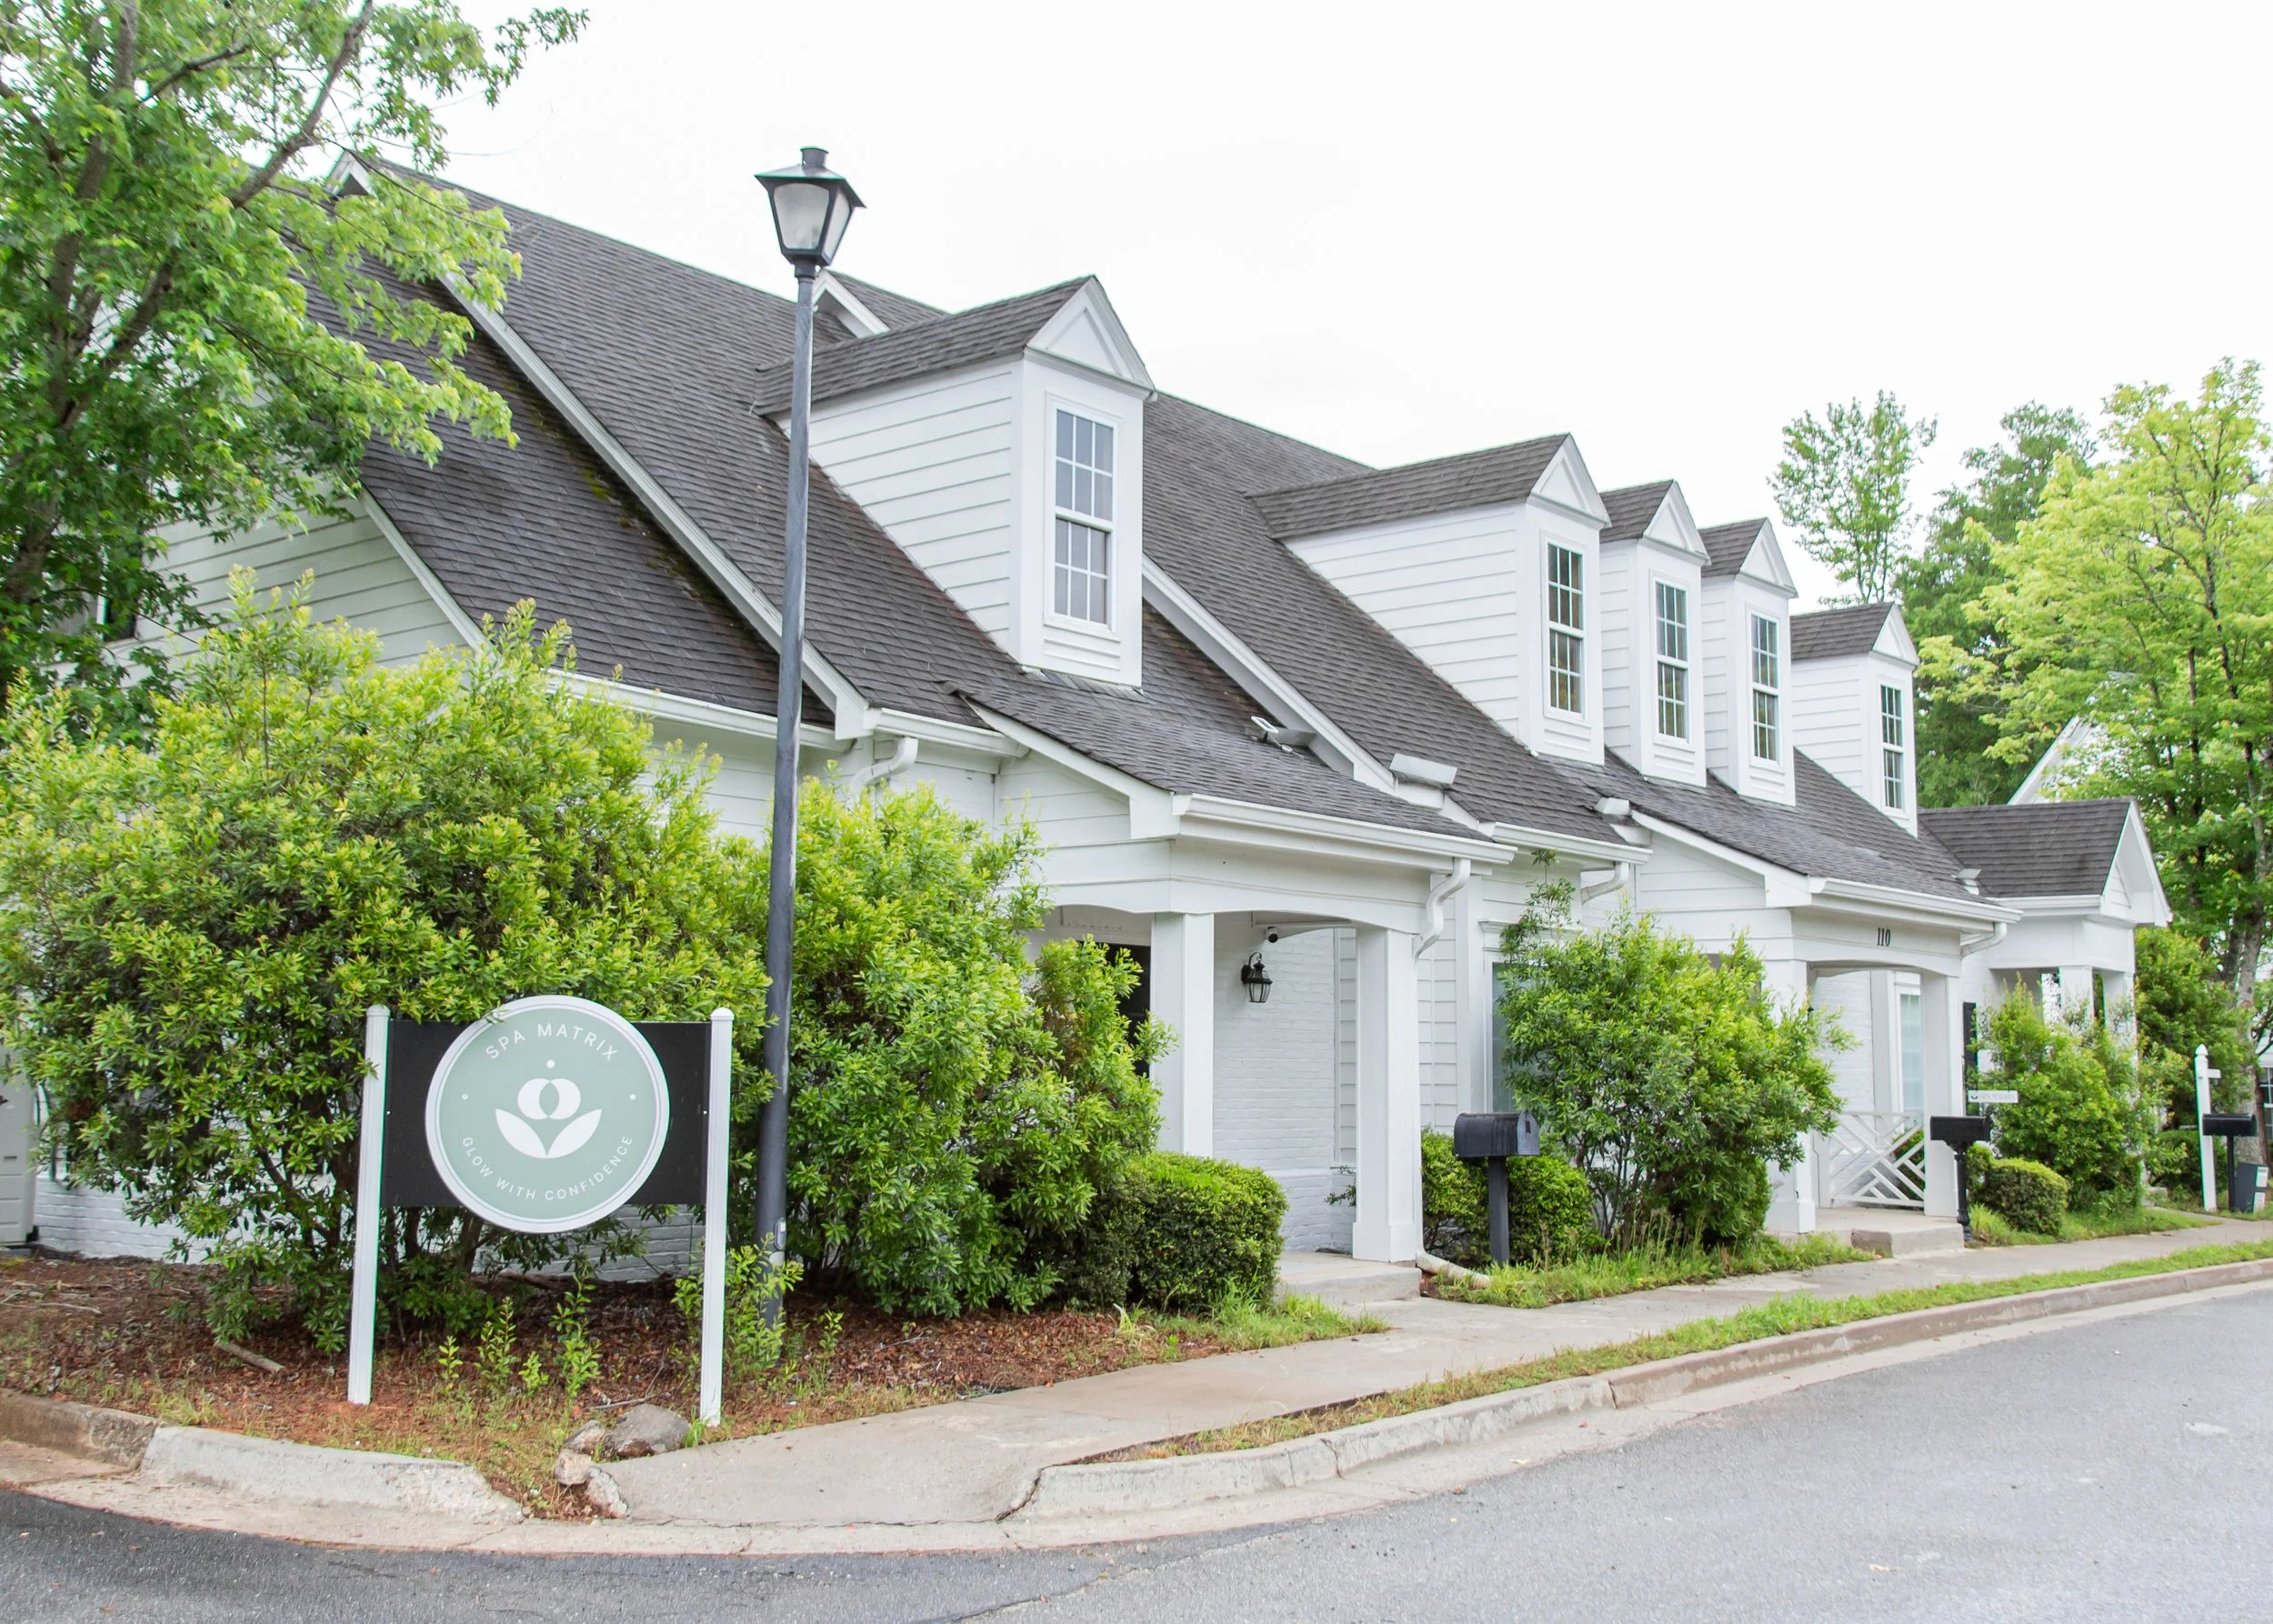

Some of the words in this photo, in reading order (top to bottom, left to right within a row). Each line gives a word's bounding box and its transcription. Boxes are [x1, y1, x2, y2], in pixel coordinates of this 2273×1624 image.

[1877, 927, 1891, 947] 110
[486, 1030, 526, 1059] SPA
[537, 1023, 618, 1061] MATRIX
[462, 1137, 493, 1178] GLOW
[496, 1177, 536, 1200] WITH
[546, 1136, 633, 1200] CONFIDENCE
